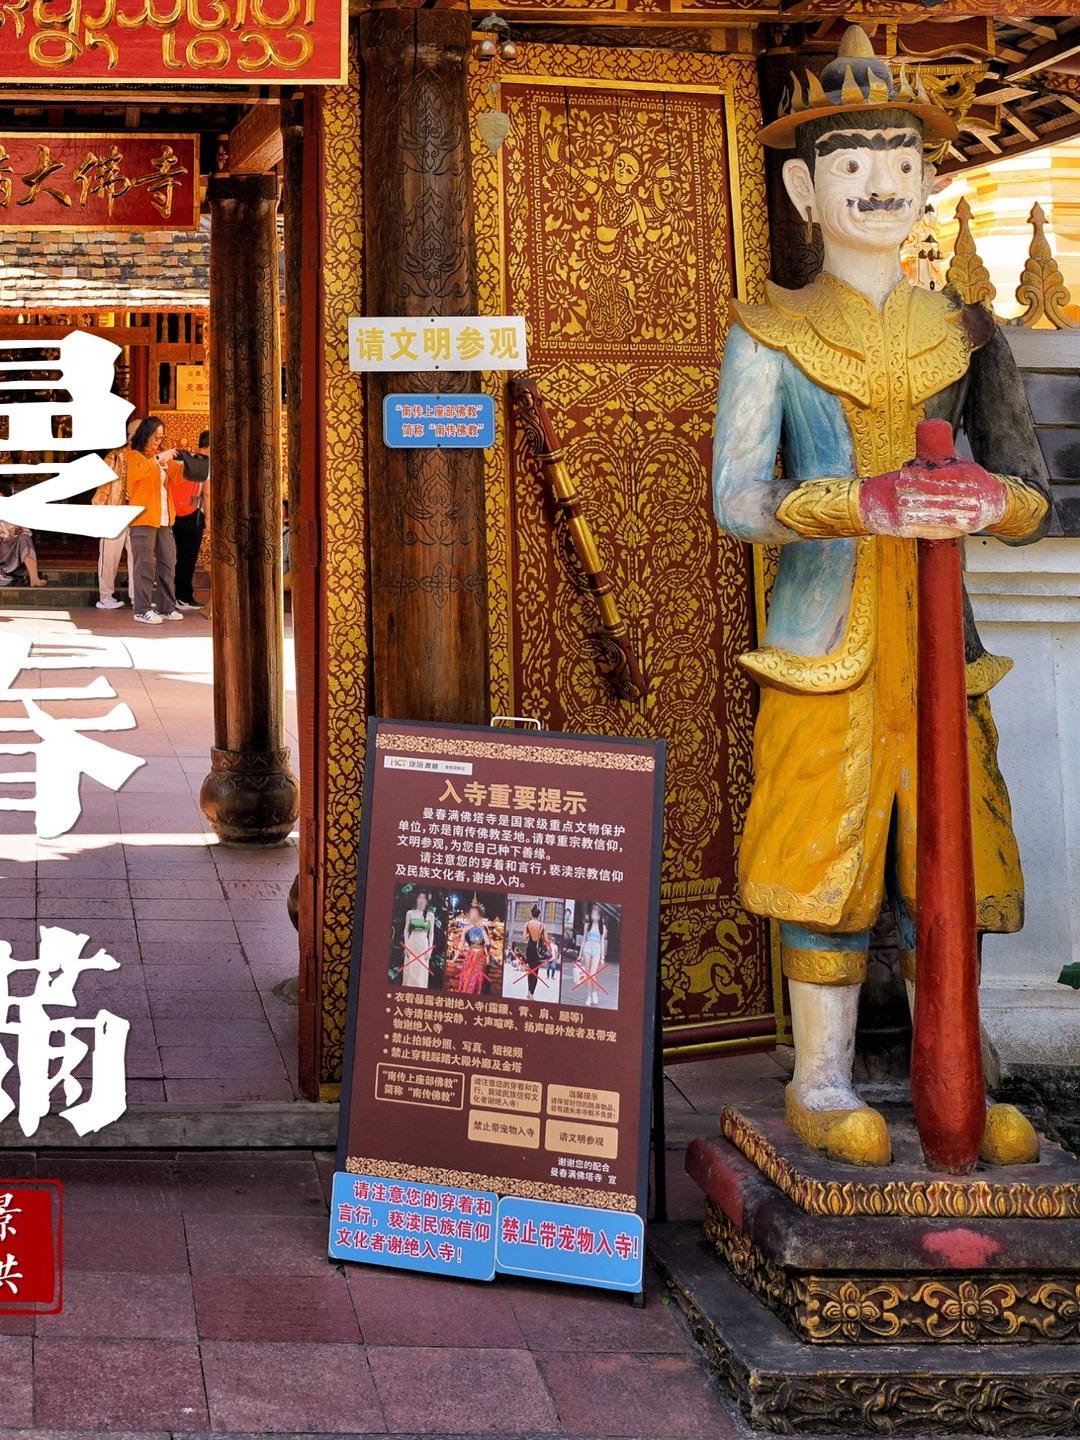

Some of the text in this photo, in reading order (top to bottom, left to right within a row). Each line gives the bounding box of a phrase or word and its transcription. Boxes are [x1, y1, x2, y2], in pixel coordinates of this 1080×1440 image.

[355, 326, 520, 361] 请文明参观
[437, 777, 587, 816] 入寺重要提示
[422, 805, 626, 838] 曼春满佛塔寺是国家级重点文物保护
[472, 1119, 535, 1138] 禁止带宠物入寺
[558, 1131, 604, 1147] 请文明参观
[557, 1156, 610, 1173] 谢谢您的配合
[607, 1174, 617, 1185] 宣
[353, 1181, 492, 1216] 请注意您的穿着和
